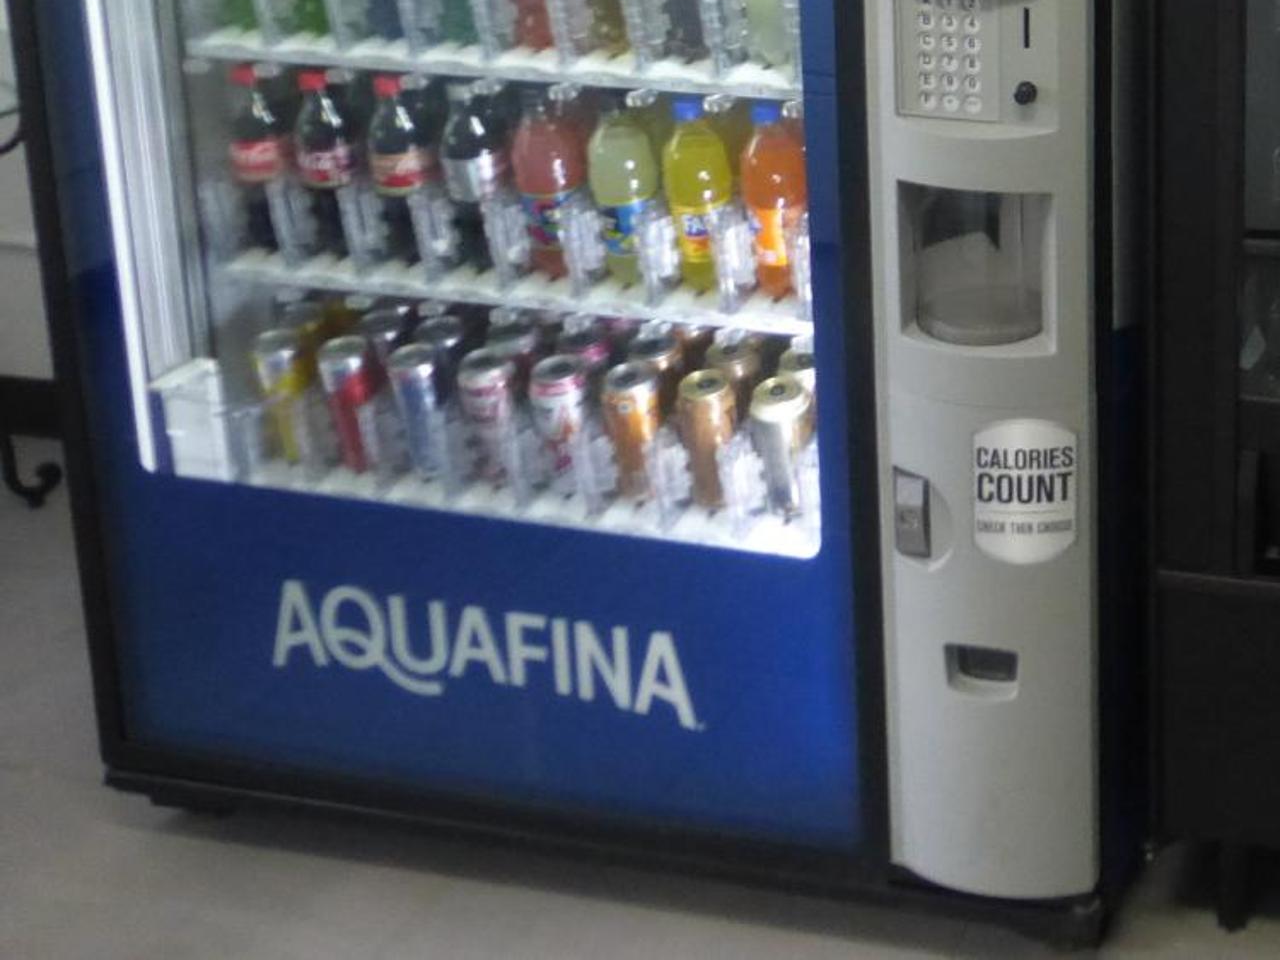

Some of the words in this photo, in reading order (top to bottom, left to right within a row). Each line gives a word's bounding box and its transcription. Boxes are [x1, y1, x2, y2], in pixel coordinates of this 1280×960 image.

[976, 446, 1074, 470] CALORIES
[976, 472, 1073, 504] COUNT
[272, 579, 703, 731] AQUAFINA
